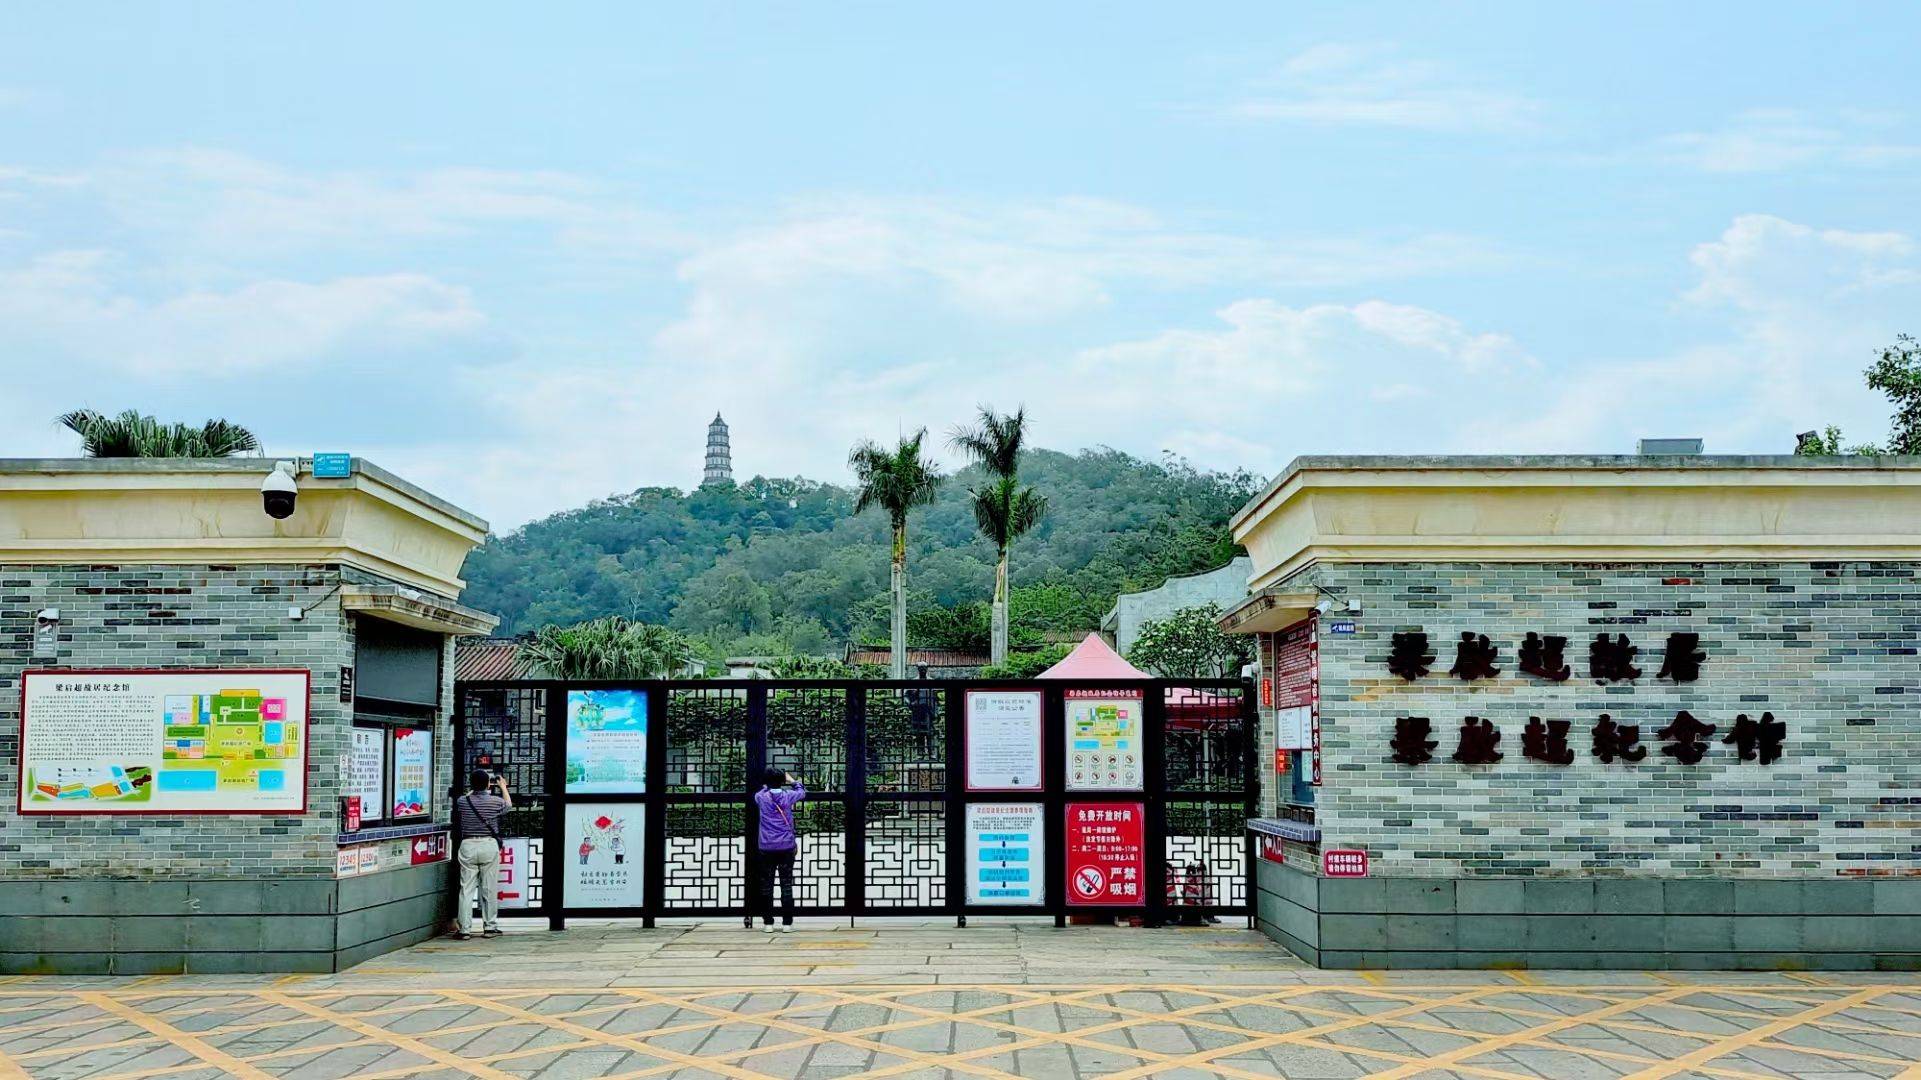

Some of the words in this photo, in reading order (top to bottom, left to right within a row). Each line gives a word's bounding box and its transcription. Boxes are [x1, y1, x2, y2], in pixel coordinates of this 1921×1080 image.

[55, 683, 130, 692] 梁启超故居纪念馆
[1078, 810, 1131, 822] 免费开放时间
[428, 835, 445, 855] 出口
[1272, 835, 1282, 856] 入口
[1110, 867, 1137, 880] 严禁
[1110, 882, 1137, 896] 吸烟
